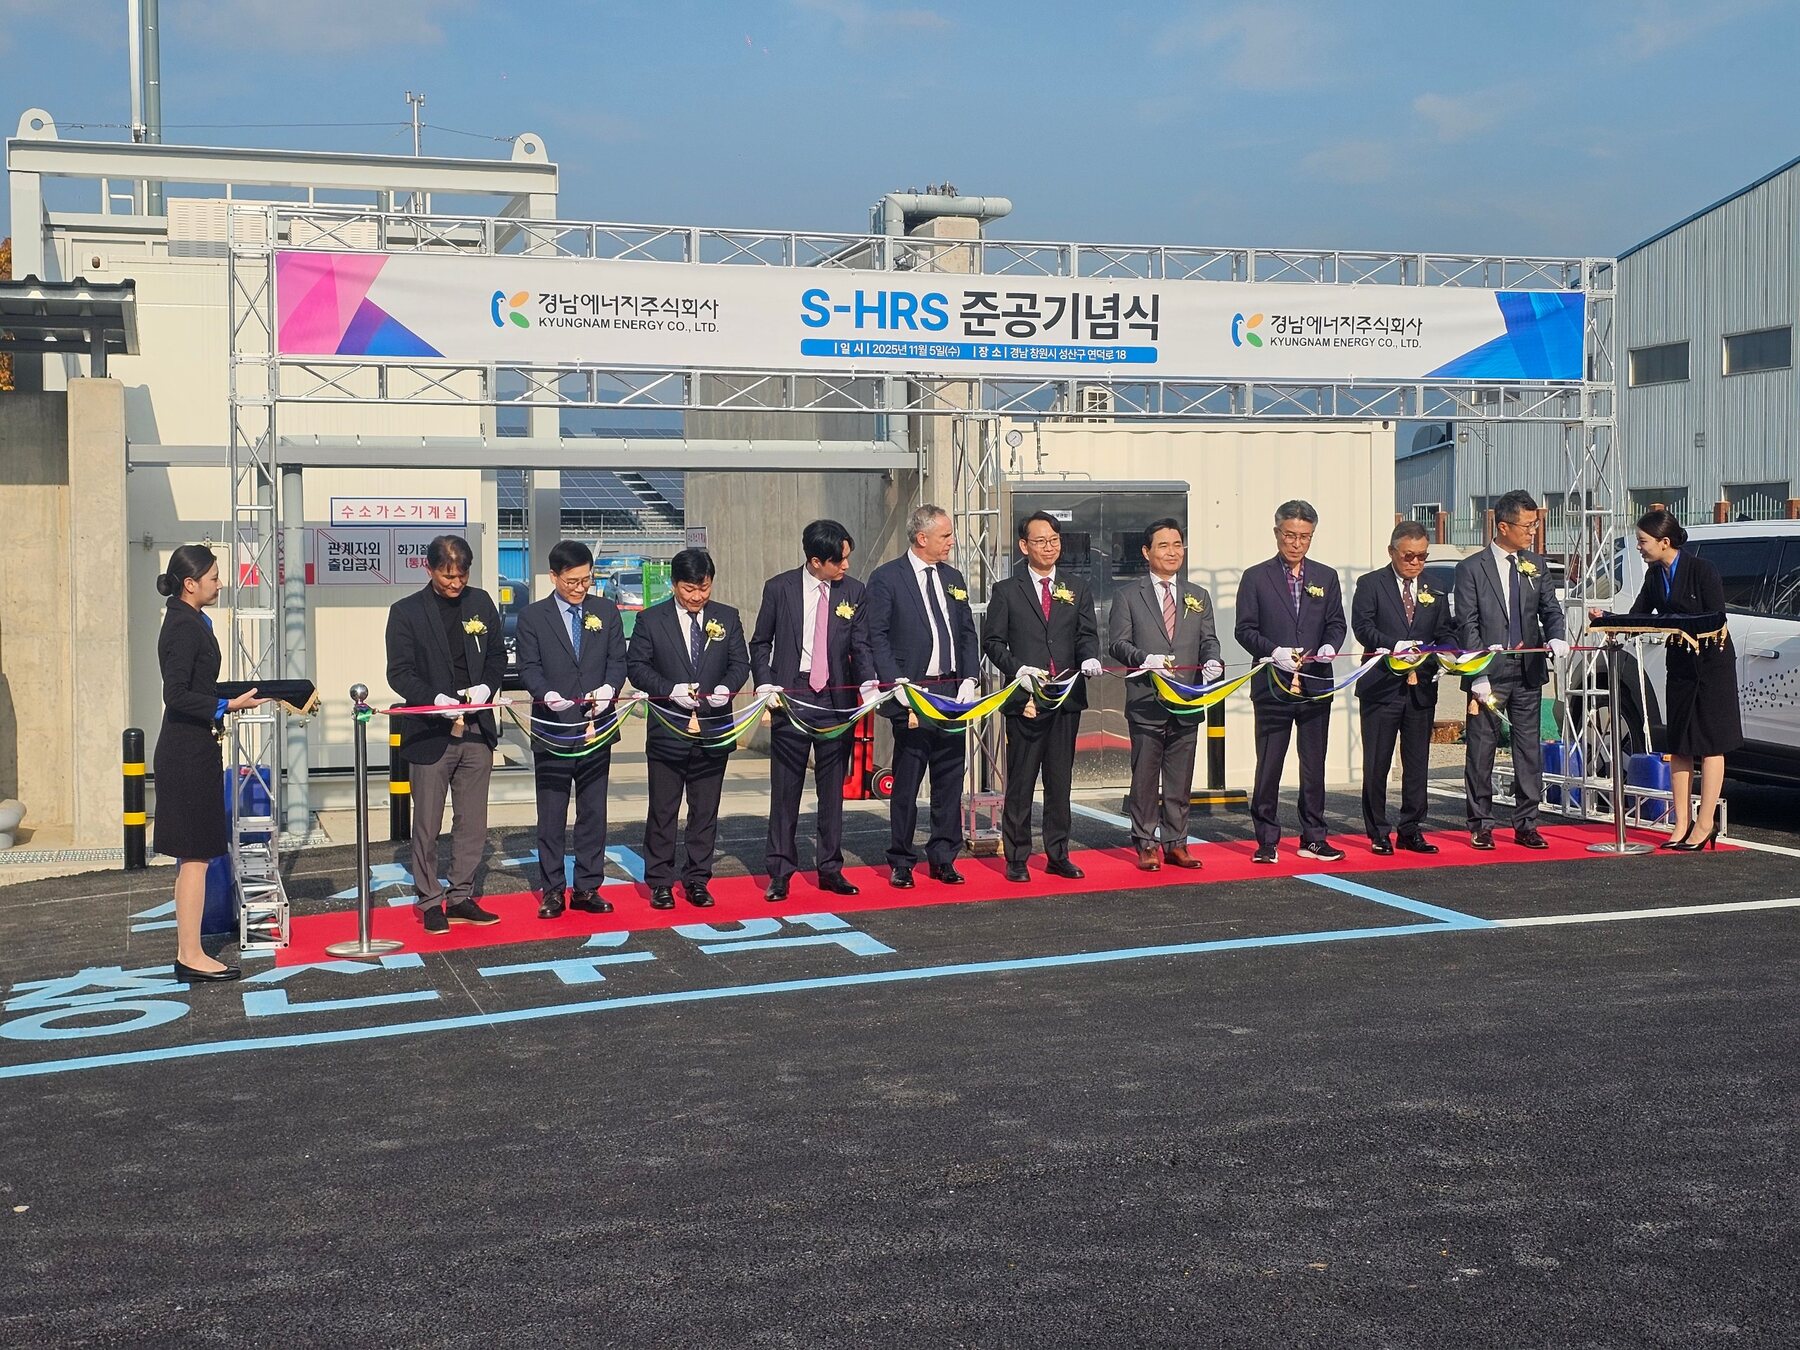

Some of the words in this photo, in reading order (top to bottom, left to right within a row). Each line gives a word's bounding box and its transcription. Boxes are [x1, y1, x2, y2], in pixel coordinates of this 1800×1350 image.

[538, 293, 719, 319] 경남에너지주식회사
[800, 288, 949, 331] S-HRS
[960, 290, 1159, 341] 준공기념식
[538, 317, 610, 329] KYUNGNAM
[613, 319, 664, 331] ENERGY
[667, 321, 692, 333] CO.,
[694, 322, 719, 333] LTD.
[1271, 315, 1423, 336] 경남에너지주식회사
[1270, 337, 1331, 347] KYUNGNAM
[1333, 337, 1376, 348] ENERGY
[1377, 338, 1398, 349] CO.,
[1400, 339, 1422, 349] LTD.
[872, 344, 907, 356] 2025년
[908, 344, 928, 357] 11월
[929, 345, 961, 358] 5일(수)
[1010, 347, 1029, 359] 경남
[1030, 347, 1056, 360] 창원시
[1059, 348, 1086, 361] 성산구
[1088, 349, 1114, 361] 연덕로
[1116, 350, 1127, 360] 18
[327, 541, 380, 556] 관계자외
[397, 544, 430, 556] 화기절
[327, 558, 381, 572] 출입금지
